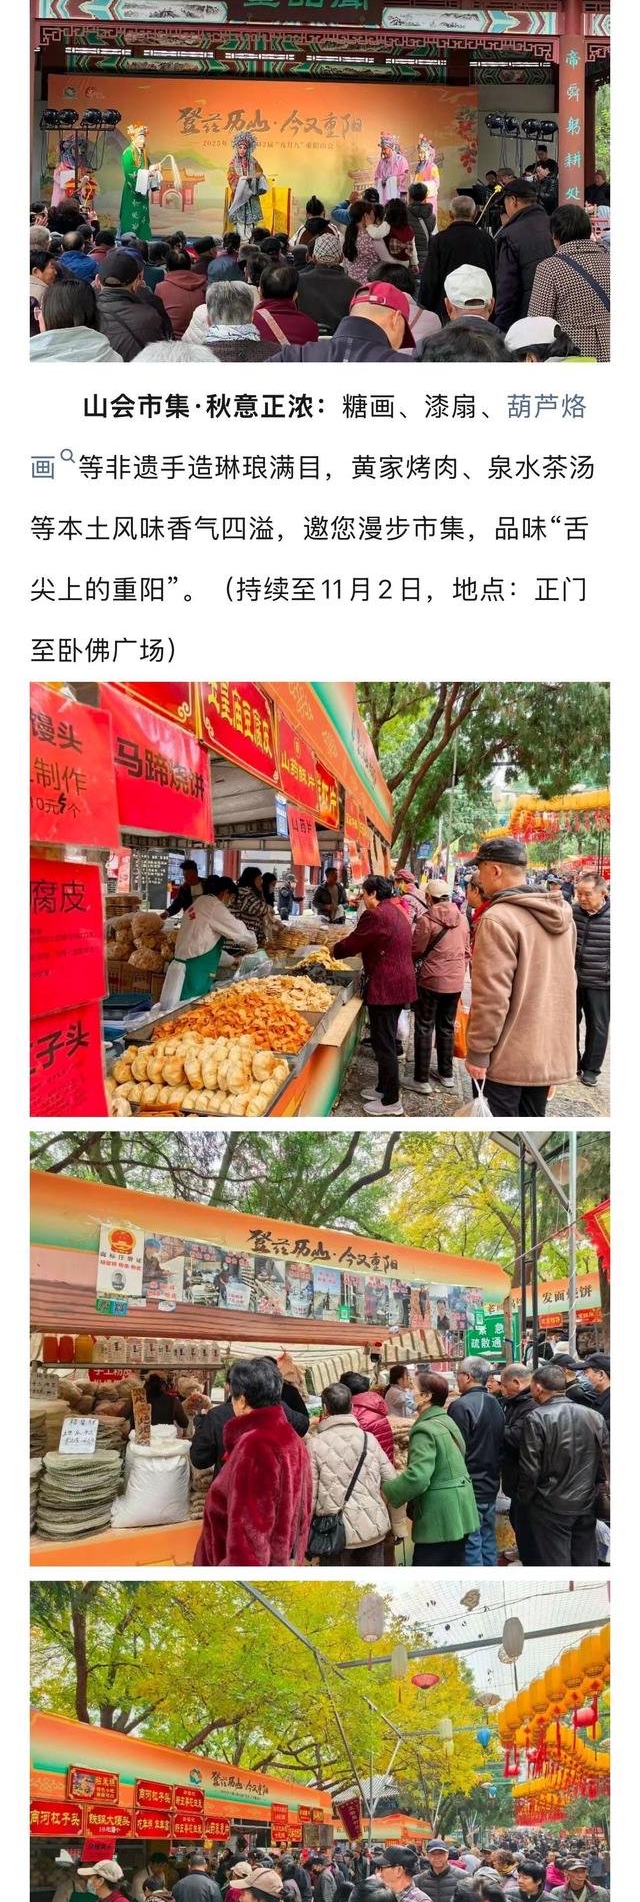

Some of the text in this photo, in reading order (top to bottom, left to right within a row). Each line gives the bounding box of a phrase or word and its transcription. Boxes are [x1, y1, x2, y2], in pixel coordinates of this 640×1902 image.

[31, 515, 588, 542] 等本土风味香气四溢，邀您漫步市集，品味“舌
[31, 638, 178, 663] 至卧佛广场）
[114, 737, 205, 801] 马蹄烧饼
[471, 1337, 505, 1349] 疏散通
